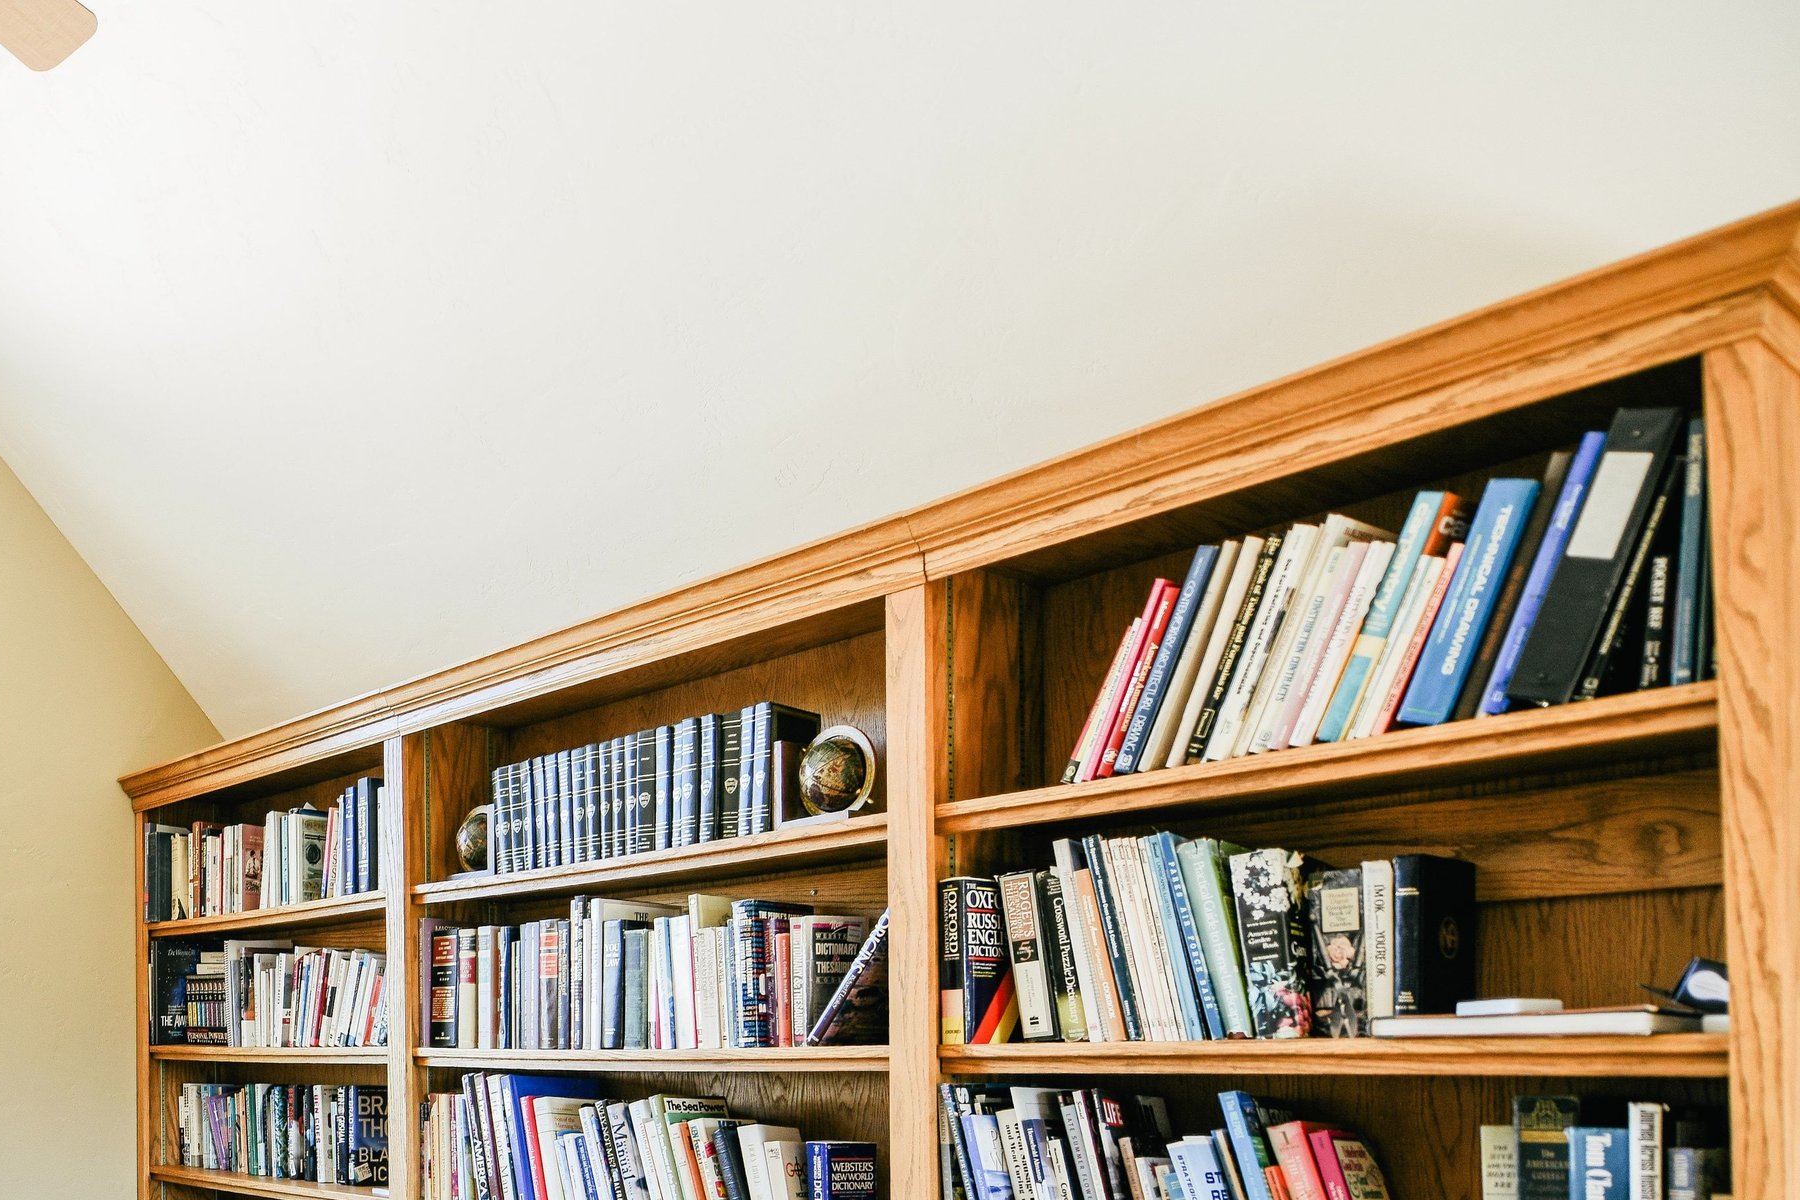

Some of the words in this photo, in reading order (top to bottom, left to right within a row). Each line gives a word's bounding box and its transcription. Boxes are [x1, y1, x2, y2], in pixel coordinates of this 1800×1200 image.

[1469, 502, 1514, 597] TECHNICAL
[1164, 578, 1197, 648] CONTEMPORARY
[1439, 594, 1480, 676] DRAWING
[1138, 641, 1158, 682] American
[1140, 647, 1172, 711] ARCHITECTURAL
[1119, 680, 1144, 733] Ammunition
[1125, 712, 1147, 751] DRAWING
[634, 912, 648, 921] THE
[946, 889, 960, 953] OXFORD
[1005, 883, 1018, 939] THESAURUS
[1019, 881, 1034, 938] ROGET'S
[1051, 896, 1070, 944] Crossword
[815, 943, 858, 955] DICTIONARY
[1166, 860, 1184, 899] PARKS
[1178, 906, 1191, 927] AIR
[1186, 934, 1204, 973] FORCE
[1198, 978, 1214, 1010] BASE
[1059, 943, 1074, 977] Puzzle
[1061, 975, 1082, 1024] Dictionary
[593, 1100, 608, 1127] WHY
[666, 1100, 682, 1112] The
[681, 1101, 698, 1112] Sea
[698, 1101, 725, 1113] Power
[945, 1107, 960, 1142] OUTDOOR
[1104, 1099, 1123, 1124] LIFE
[599, 1126, 612, 1148] NOT
[611, 1120, 636, 1180] Manual
[1025, 1127, 1039, 1158] Household
[1064, 1111, 1075, 1131] LATE
[1070, 1134, 1085, 1170] SUMMER
[1585, 1132, 1612, 1167] Tom
[604, 1147, 617, 1168] ME?
[831, 1161, 874, 1172] WEBSTER'S
[1031, 1157, 1044, 1182] Almanac
[831, 1181, 874, 1191] DICTIONARY
